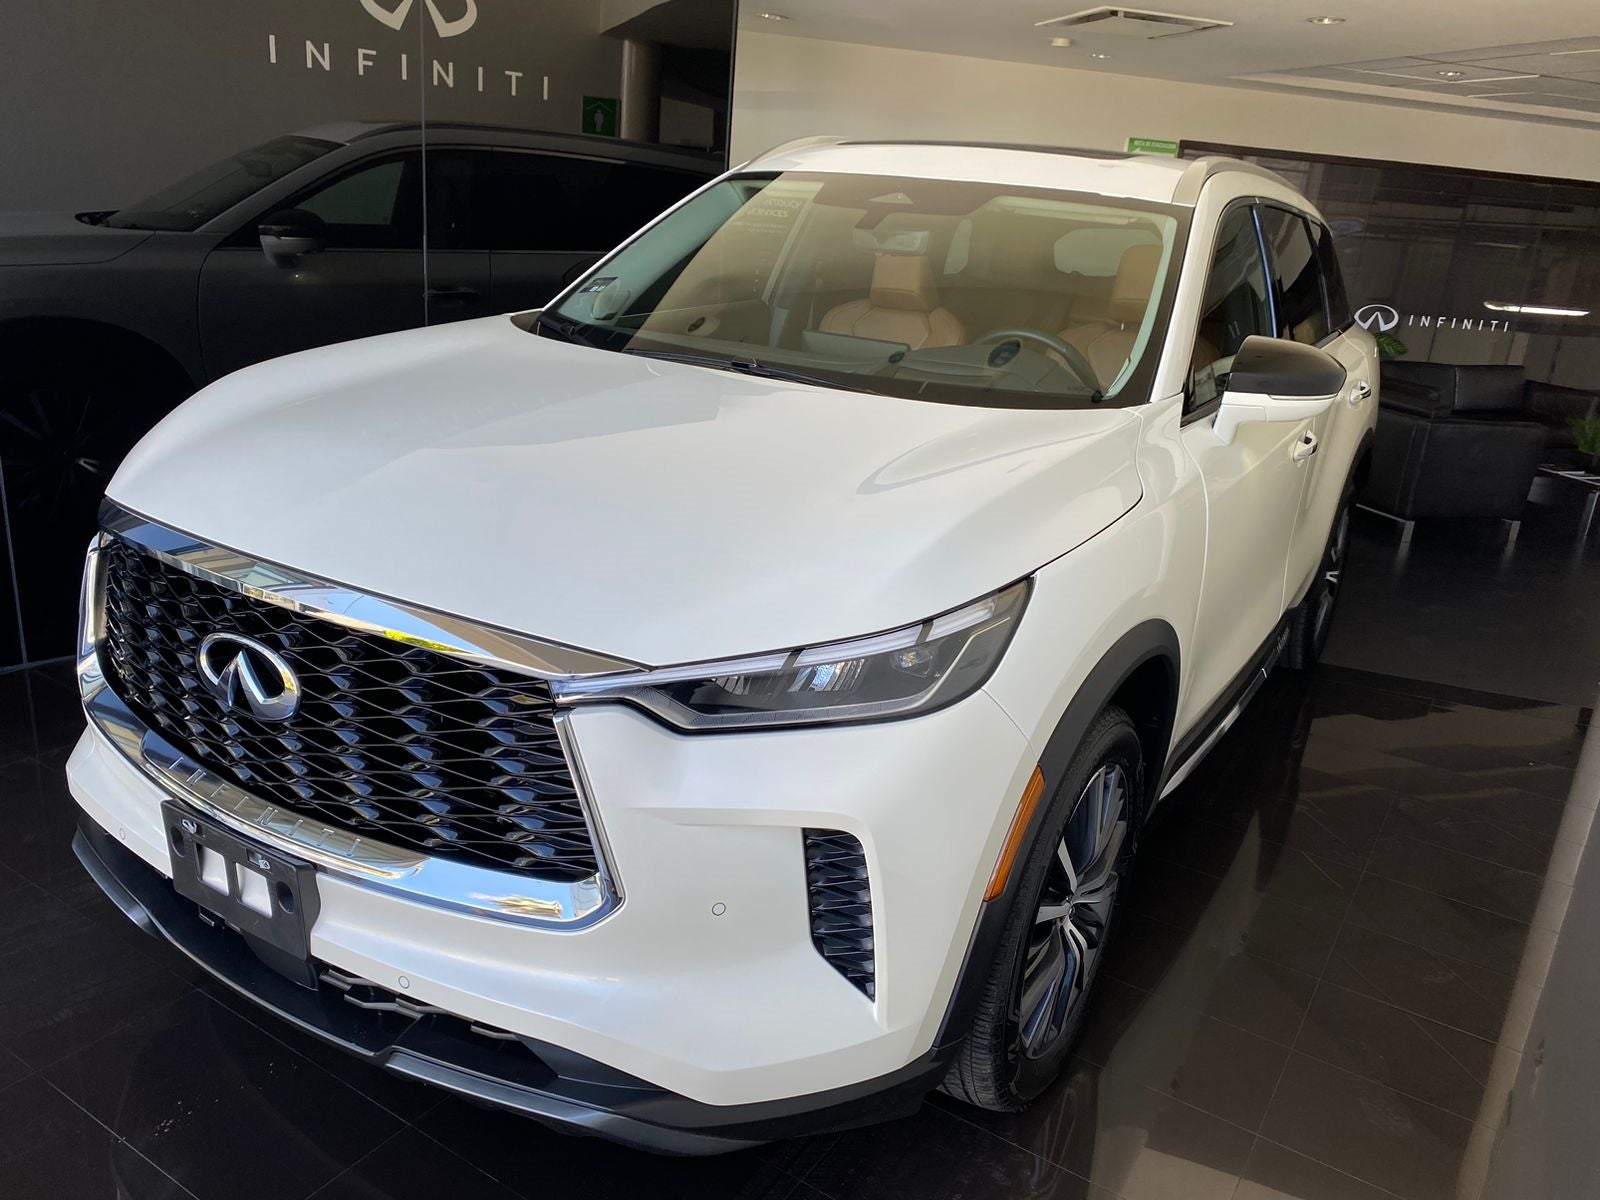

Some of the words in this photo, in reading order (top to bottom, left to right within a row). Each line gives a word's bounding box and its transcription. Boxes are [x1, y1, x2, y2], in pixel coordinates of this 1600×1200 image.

[268, 34, 549, 100] INFINITI
[1408, 314, 1509, 332] INFINITI
[168, 756, 362, 857] INFINITI
